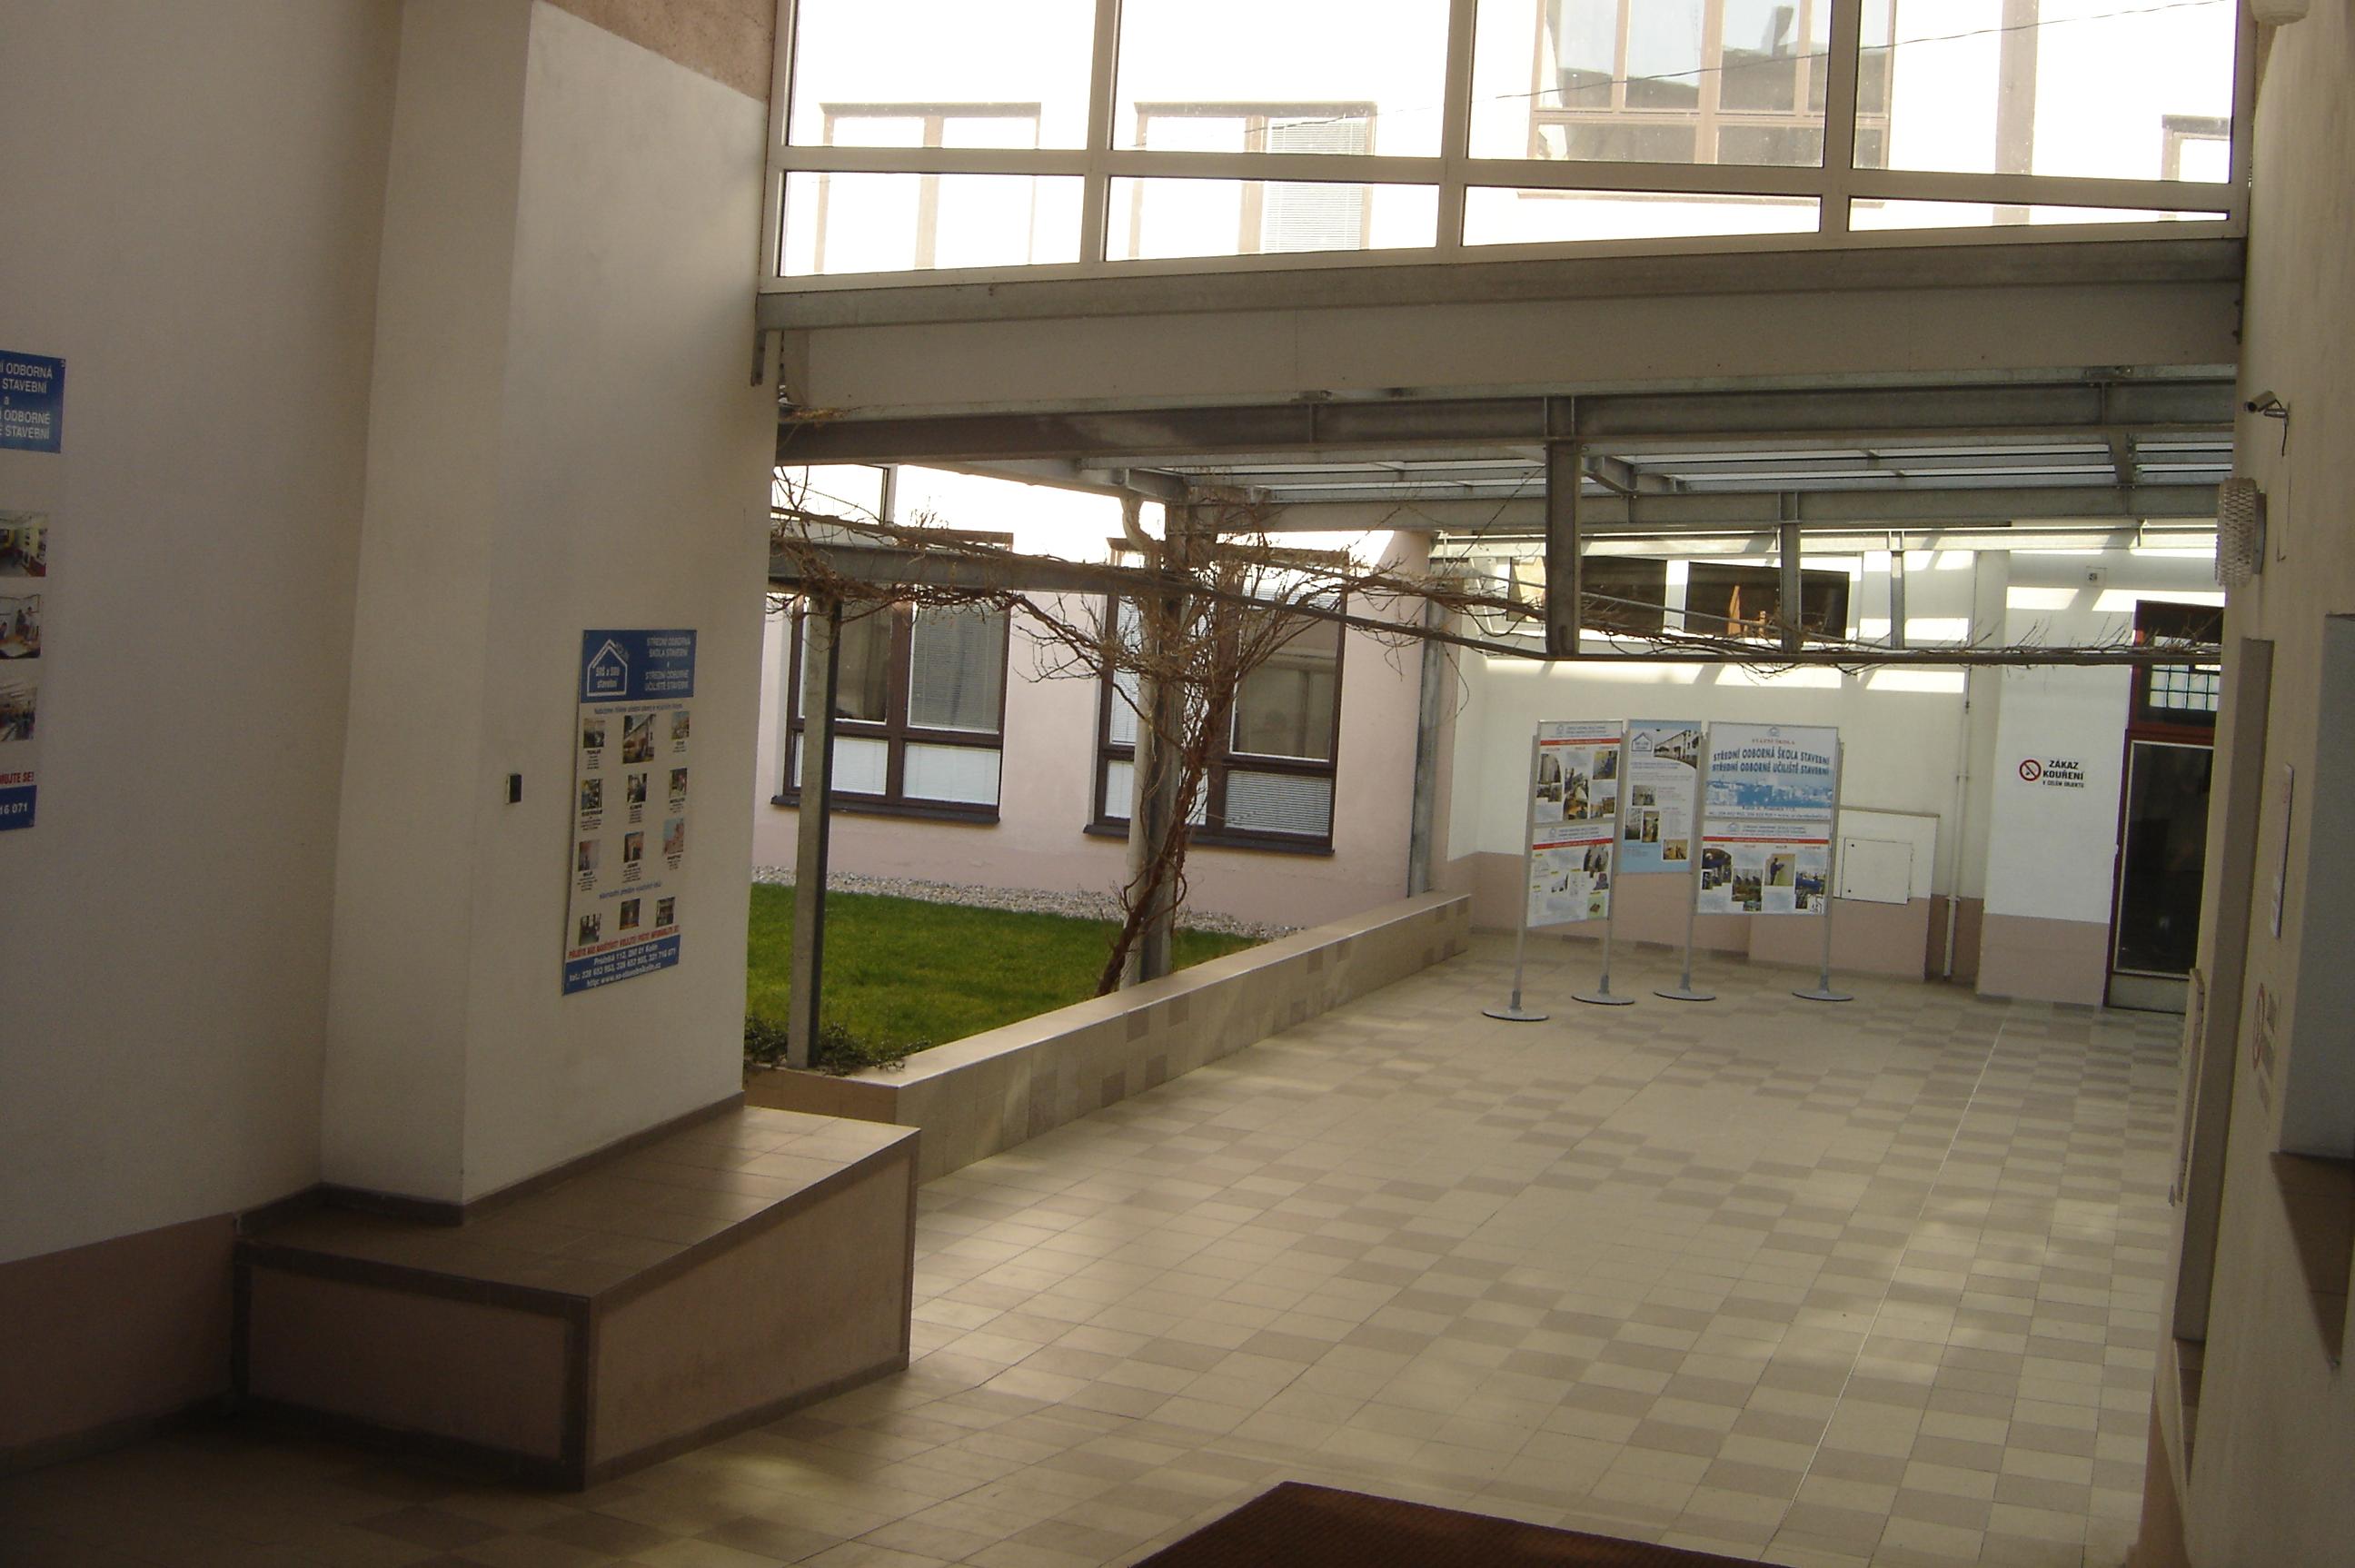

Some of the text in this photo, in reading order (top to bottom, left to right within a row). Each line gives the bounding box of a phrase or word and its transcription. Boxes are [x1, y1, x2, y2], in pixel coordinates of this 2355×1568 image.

[6, 362, 53, 380] ODBORNÁ
[2, 378, 47, 393] STAVEBNÍ
[4, 396, 10, 405] a
[4, 410, 51, 424] ODBORNÉ
[5, 425, 50, 440] STAVEBNÍ
[1713, 746, 1830, 766] STŘEDNÍ ODBORNÁ ŠKOLA STAVEBNÍ
[2049, 759, 2079, 769] ZÁKAZ
[2042, 769, 2084, 780] KOUŘENÍ
